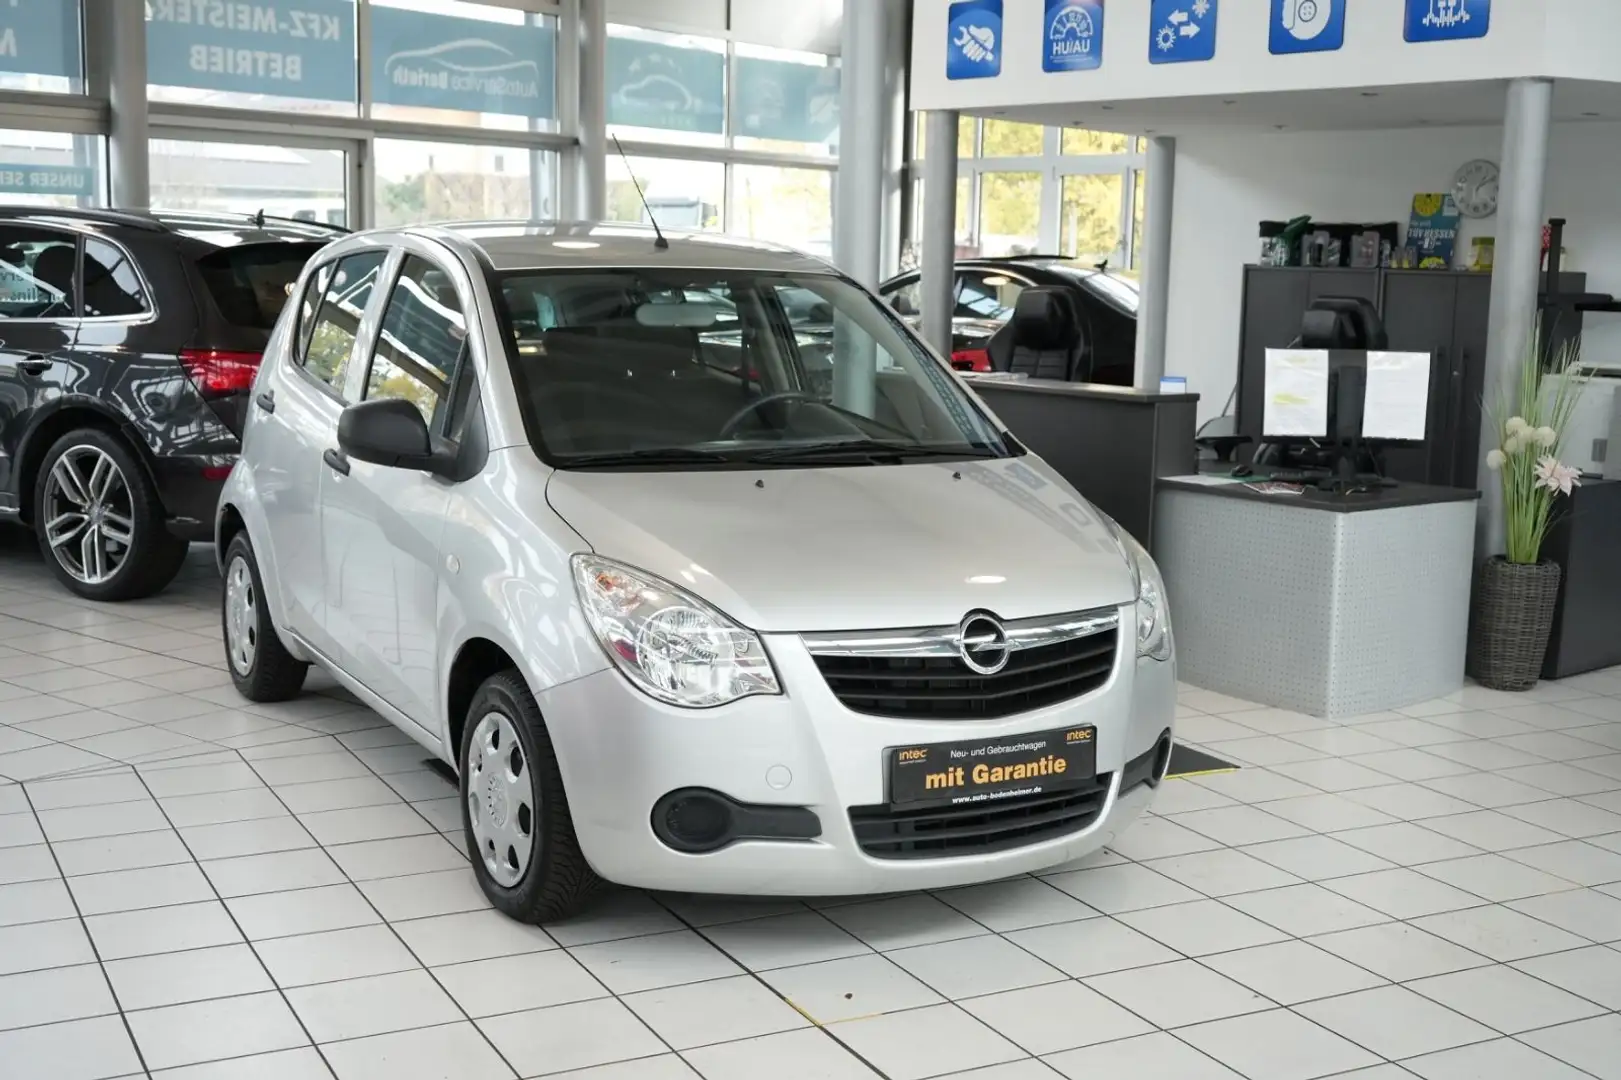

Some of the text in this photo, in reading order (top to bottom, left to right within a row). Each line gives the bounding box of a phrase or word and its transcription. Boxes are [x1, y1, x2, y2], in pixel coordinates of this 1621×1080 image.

[1053, 39, 1090, 55] HU/AU
[1066, 729, 1092, 740] intec
[899, 749, 927, 760] intec
[950, 740, 1046, 759] Neu- und Gebrauchtwagen
[925, 755, 1067, 789] mit Garantie
